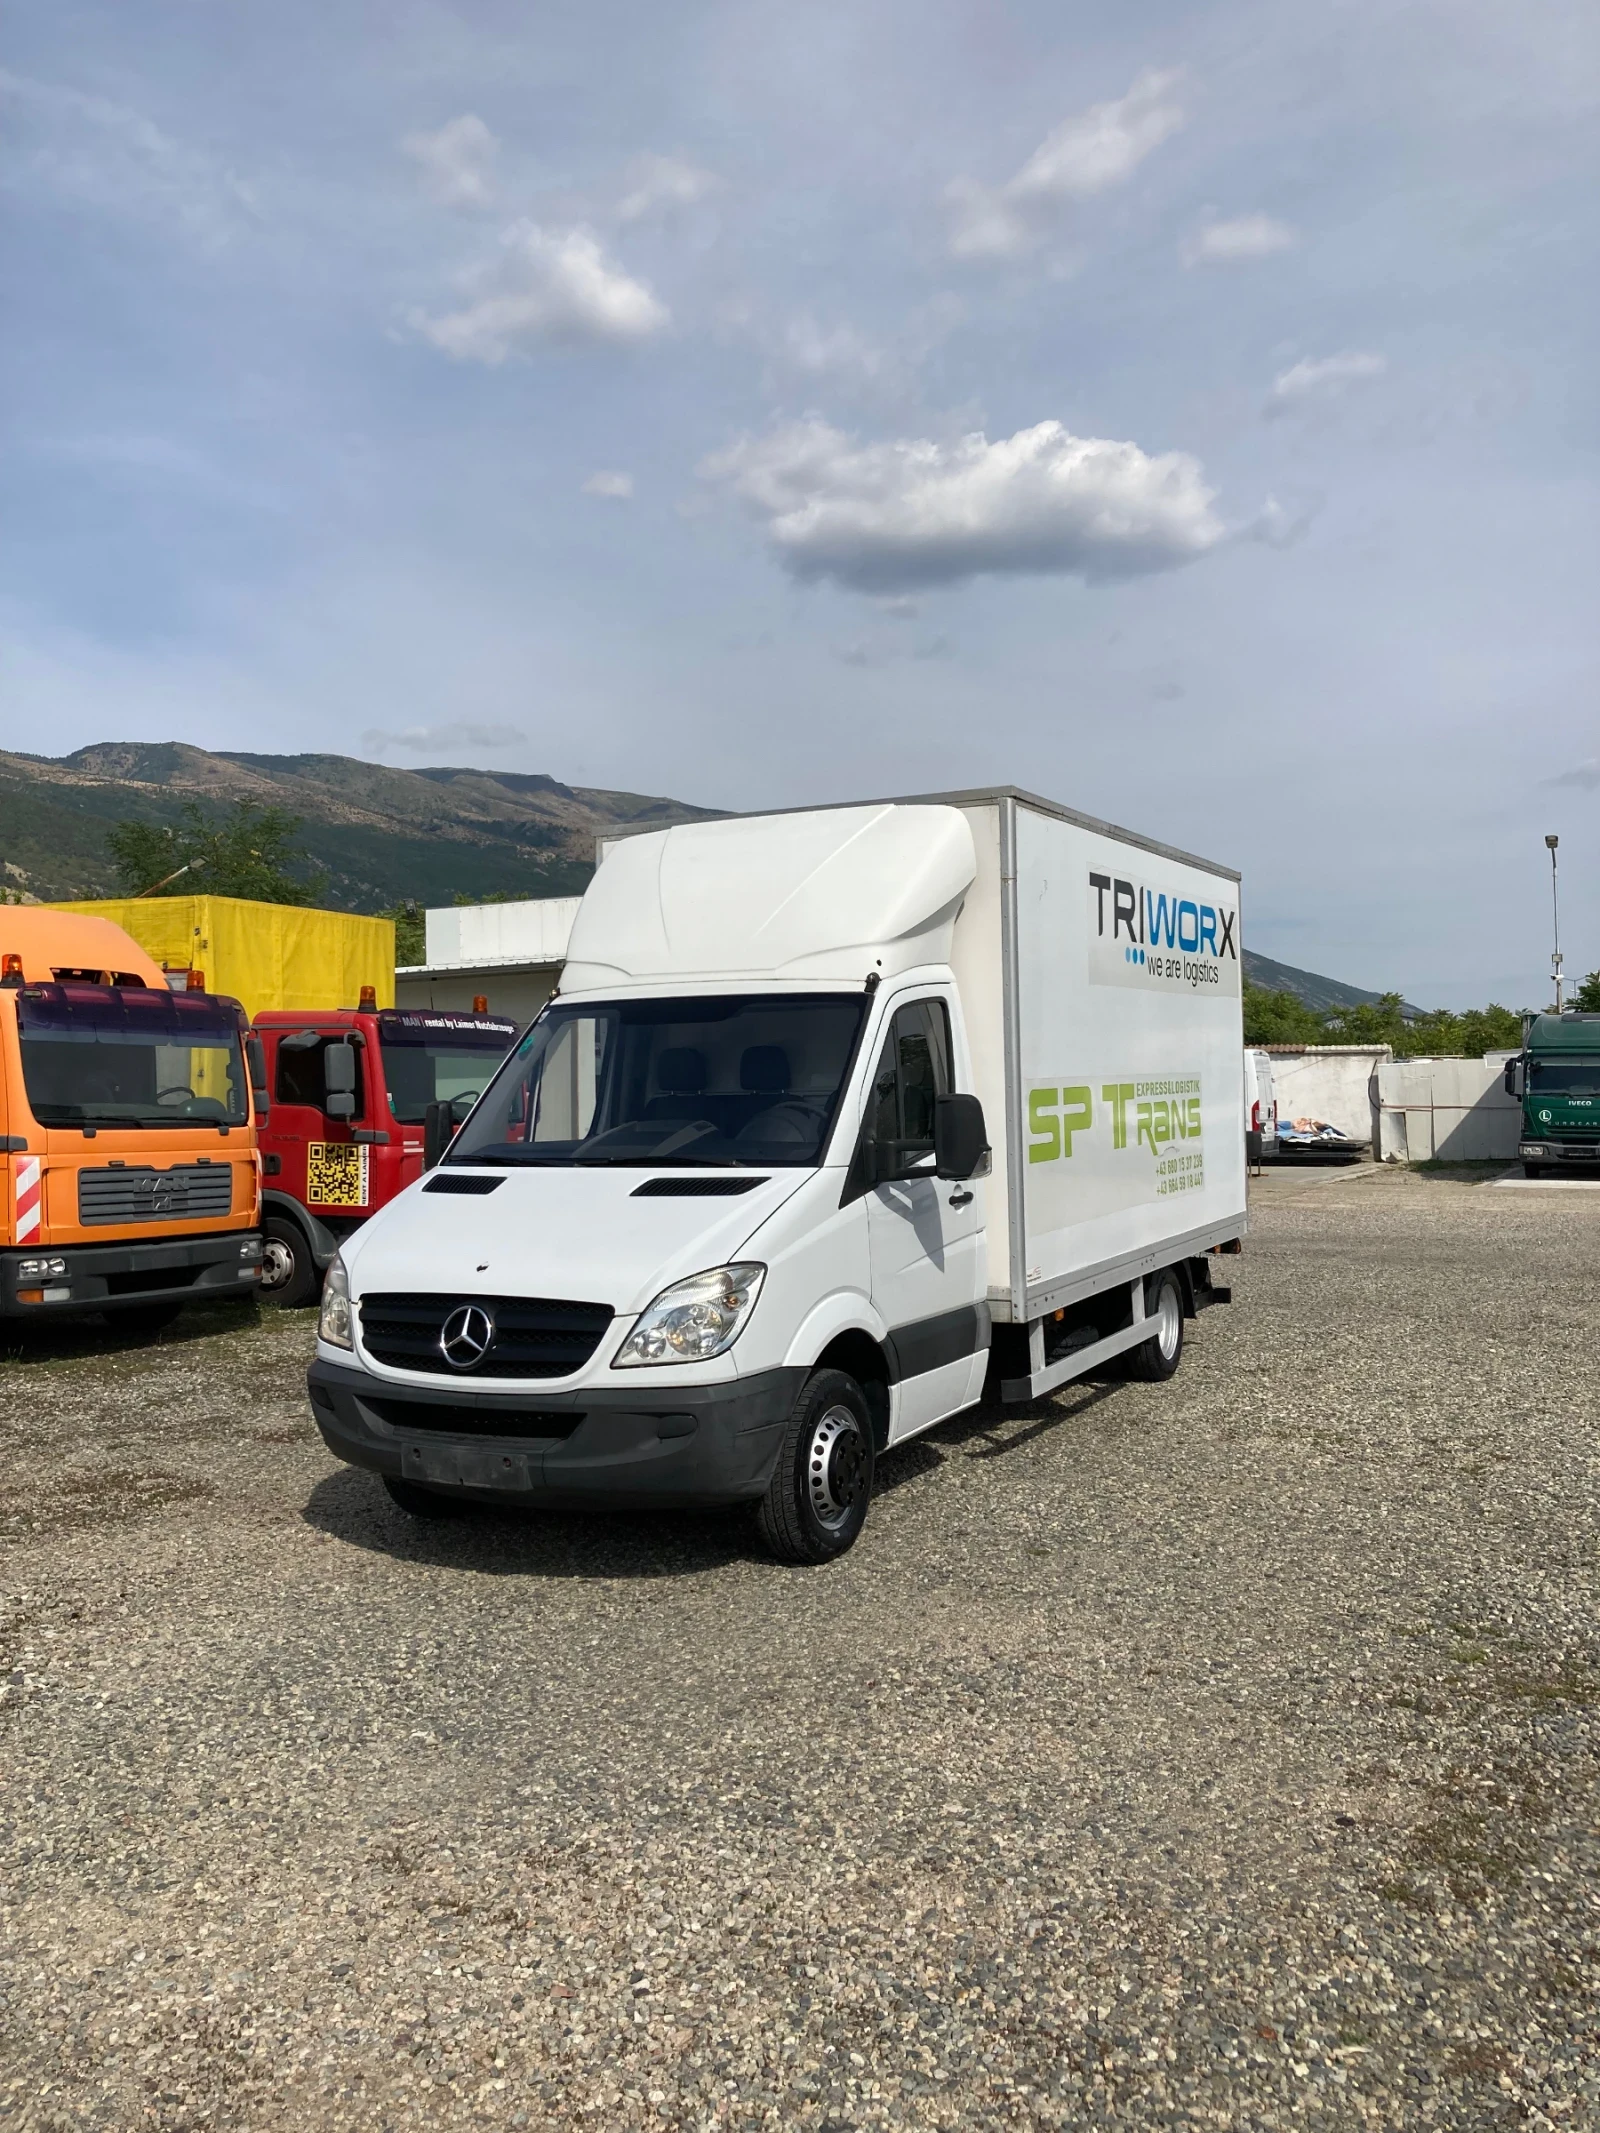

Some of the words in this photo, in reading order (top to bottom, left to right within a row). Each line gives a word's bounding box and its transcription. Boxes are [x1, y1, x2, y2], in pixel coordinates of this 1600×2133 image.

[1089, 872, 1236, 960] TRIWORX
[1147, 956, 1163, 976] we
[1165, 958, 1181, 979] are
[1183, 956, 1219, 987] logistics
[402, 1017, 420, 1027] MAN
[425, 1018, 445, 1028] rental
[445, 1019, 454, 1030] by
[454, 1020, 475, 1029] Laimer
[1029, 1086, 1092, 1164] SP
[1156, 1161, 1166, 1177] +43
[133, 1177, 189, 1193] MAN
[1157, 1180, 1167, 1196] +43
